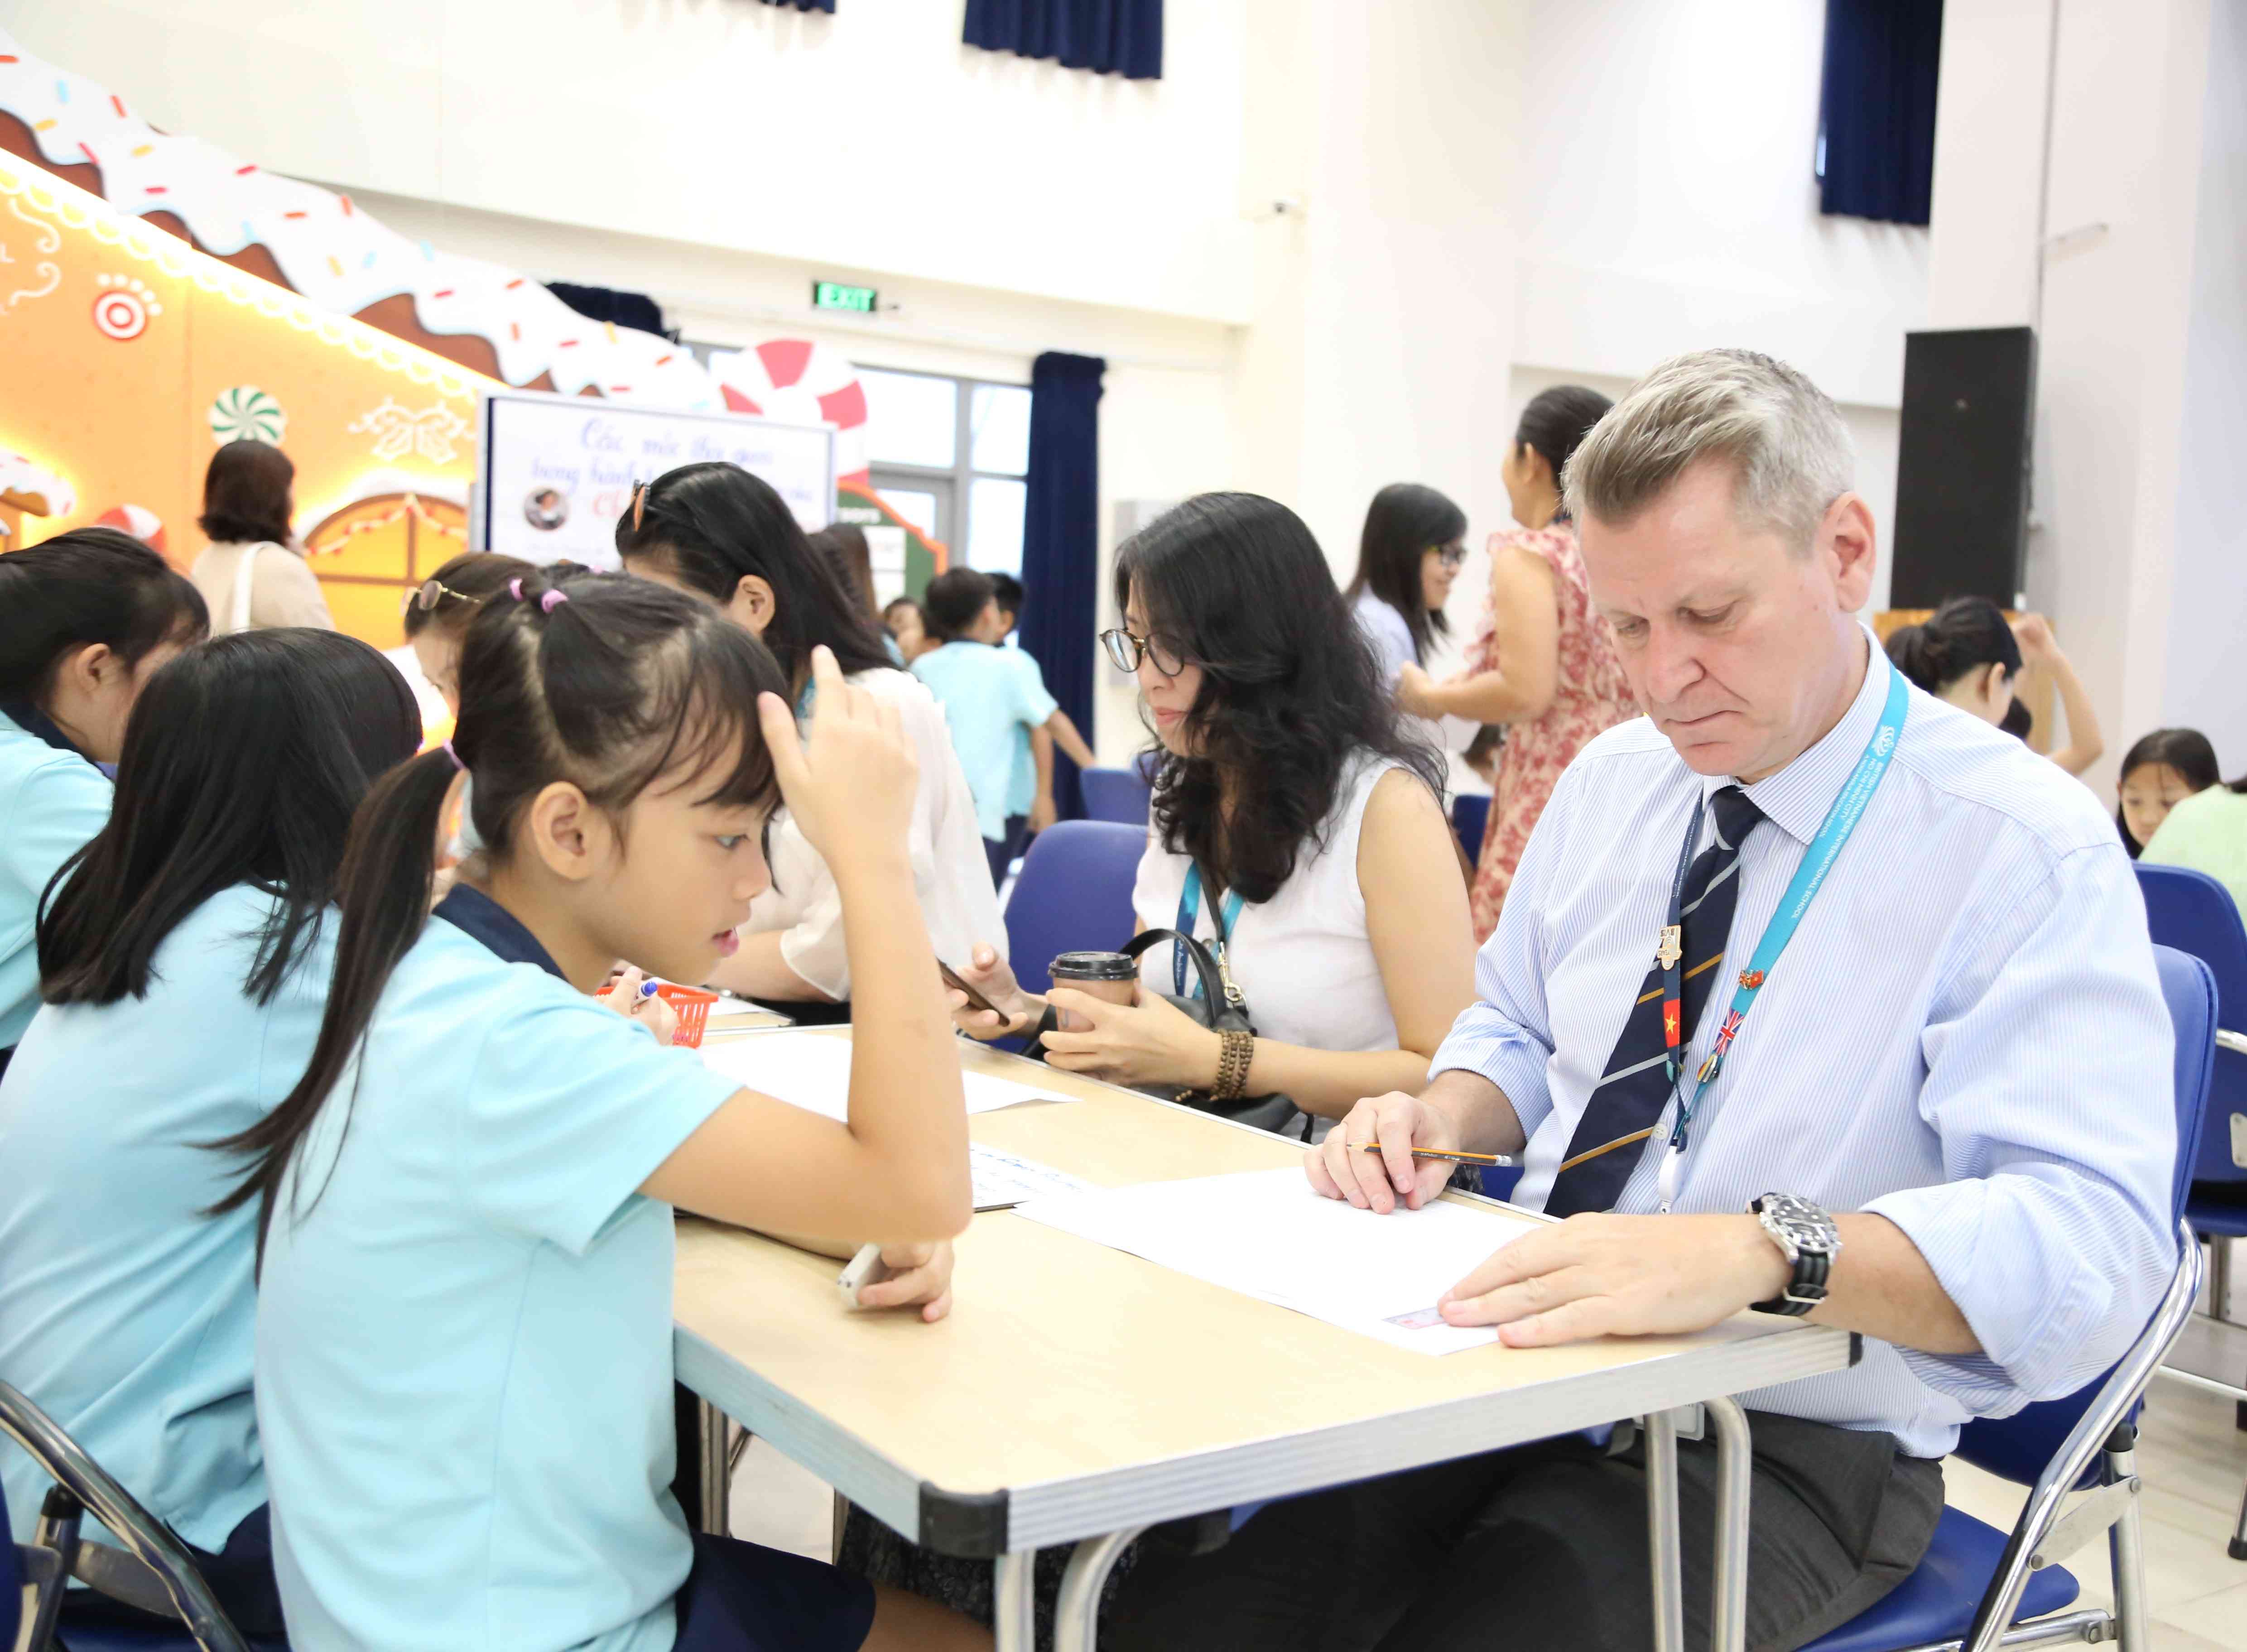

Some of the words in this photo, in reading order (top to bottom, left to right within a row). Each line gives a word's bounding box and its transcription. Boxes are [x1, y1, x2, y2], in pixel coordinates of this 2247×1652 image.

[819, 283, 876, 312] EXIT
[1848, 782, 1864, 805] MINH
[1807, 833, 1844, 891] INTERNATIONAL
[1790, 888, 1813, 921] SCHOOL
